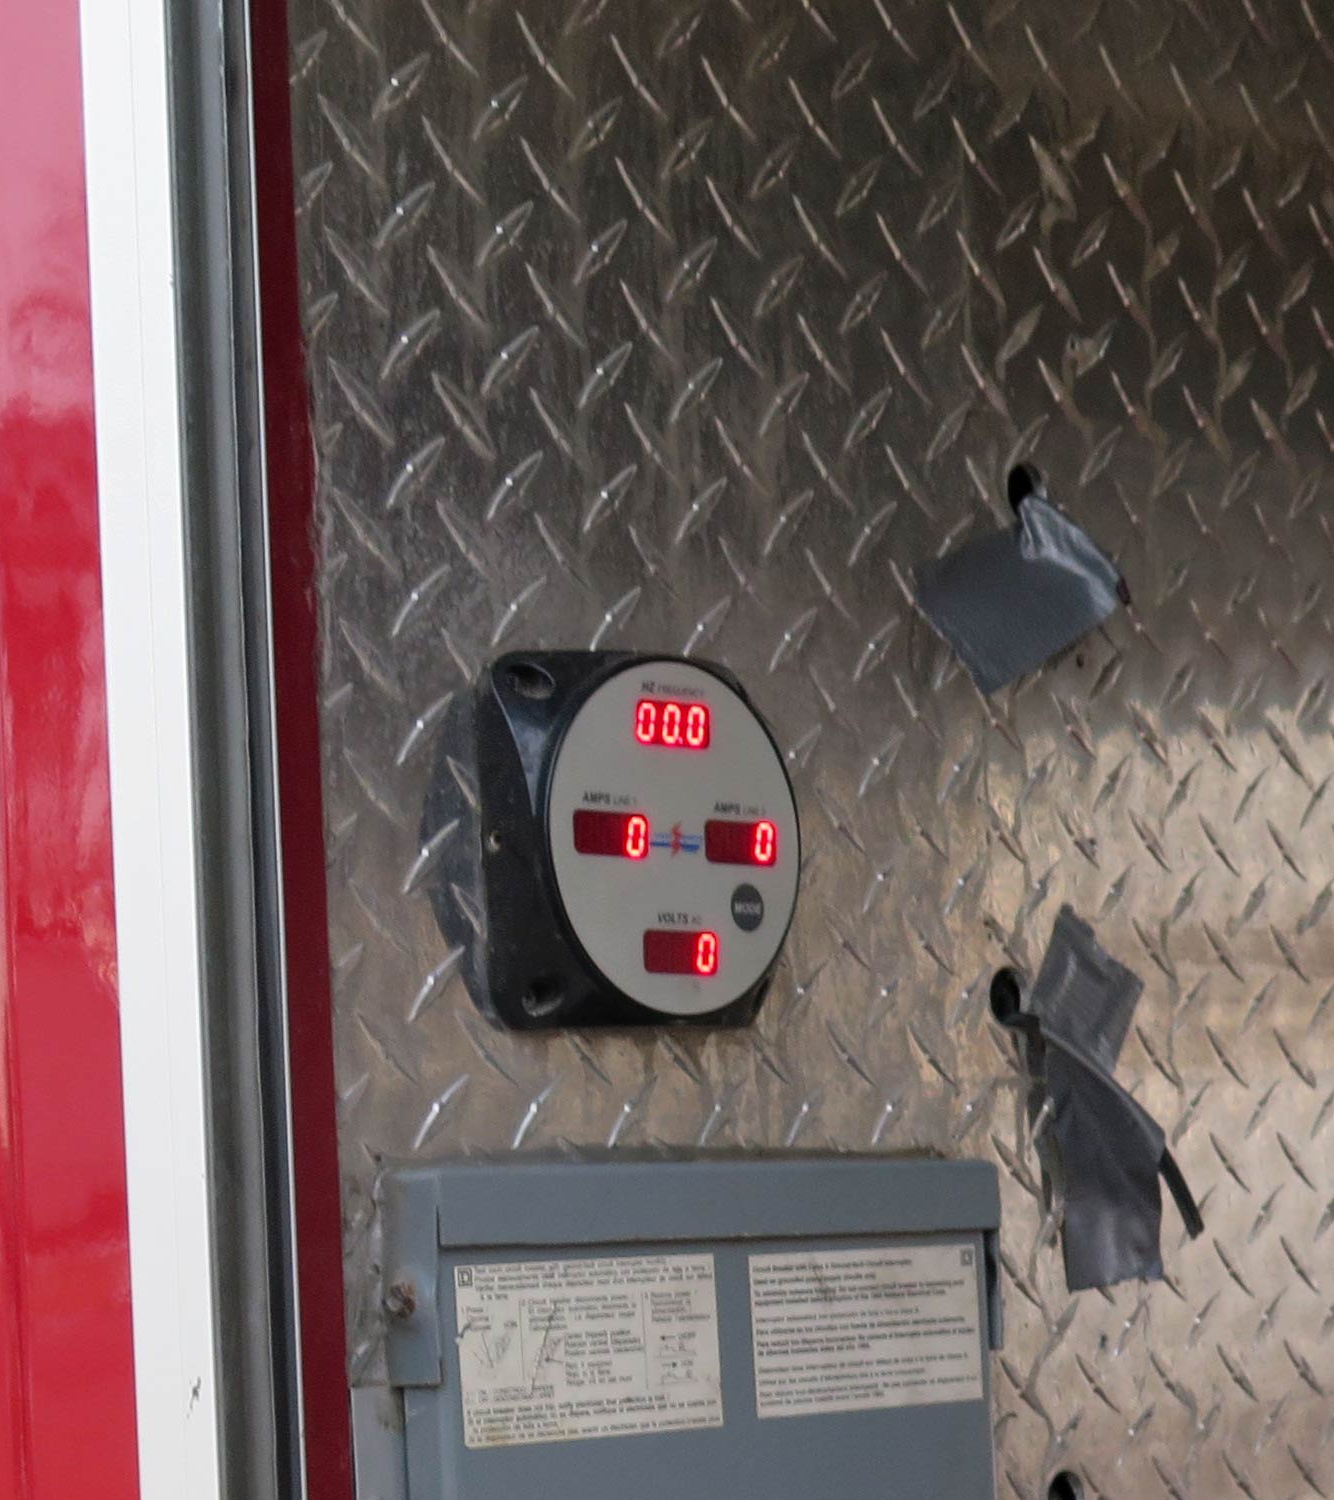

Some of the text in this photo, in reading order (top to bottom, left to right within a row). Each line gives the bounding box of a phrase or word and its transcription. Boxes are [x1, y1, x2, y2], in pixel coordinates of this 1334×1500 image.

[582, 791, 611, 805] AMPS
[626, 815, 646, 858] 0
[755, 820, 773, 862] 0
[658, 912, 689, 926] VOLTS
[696, 932, 715, 975] 0
